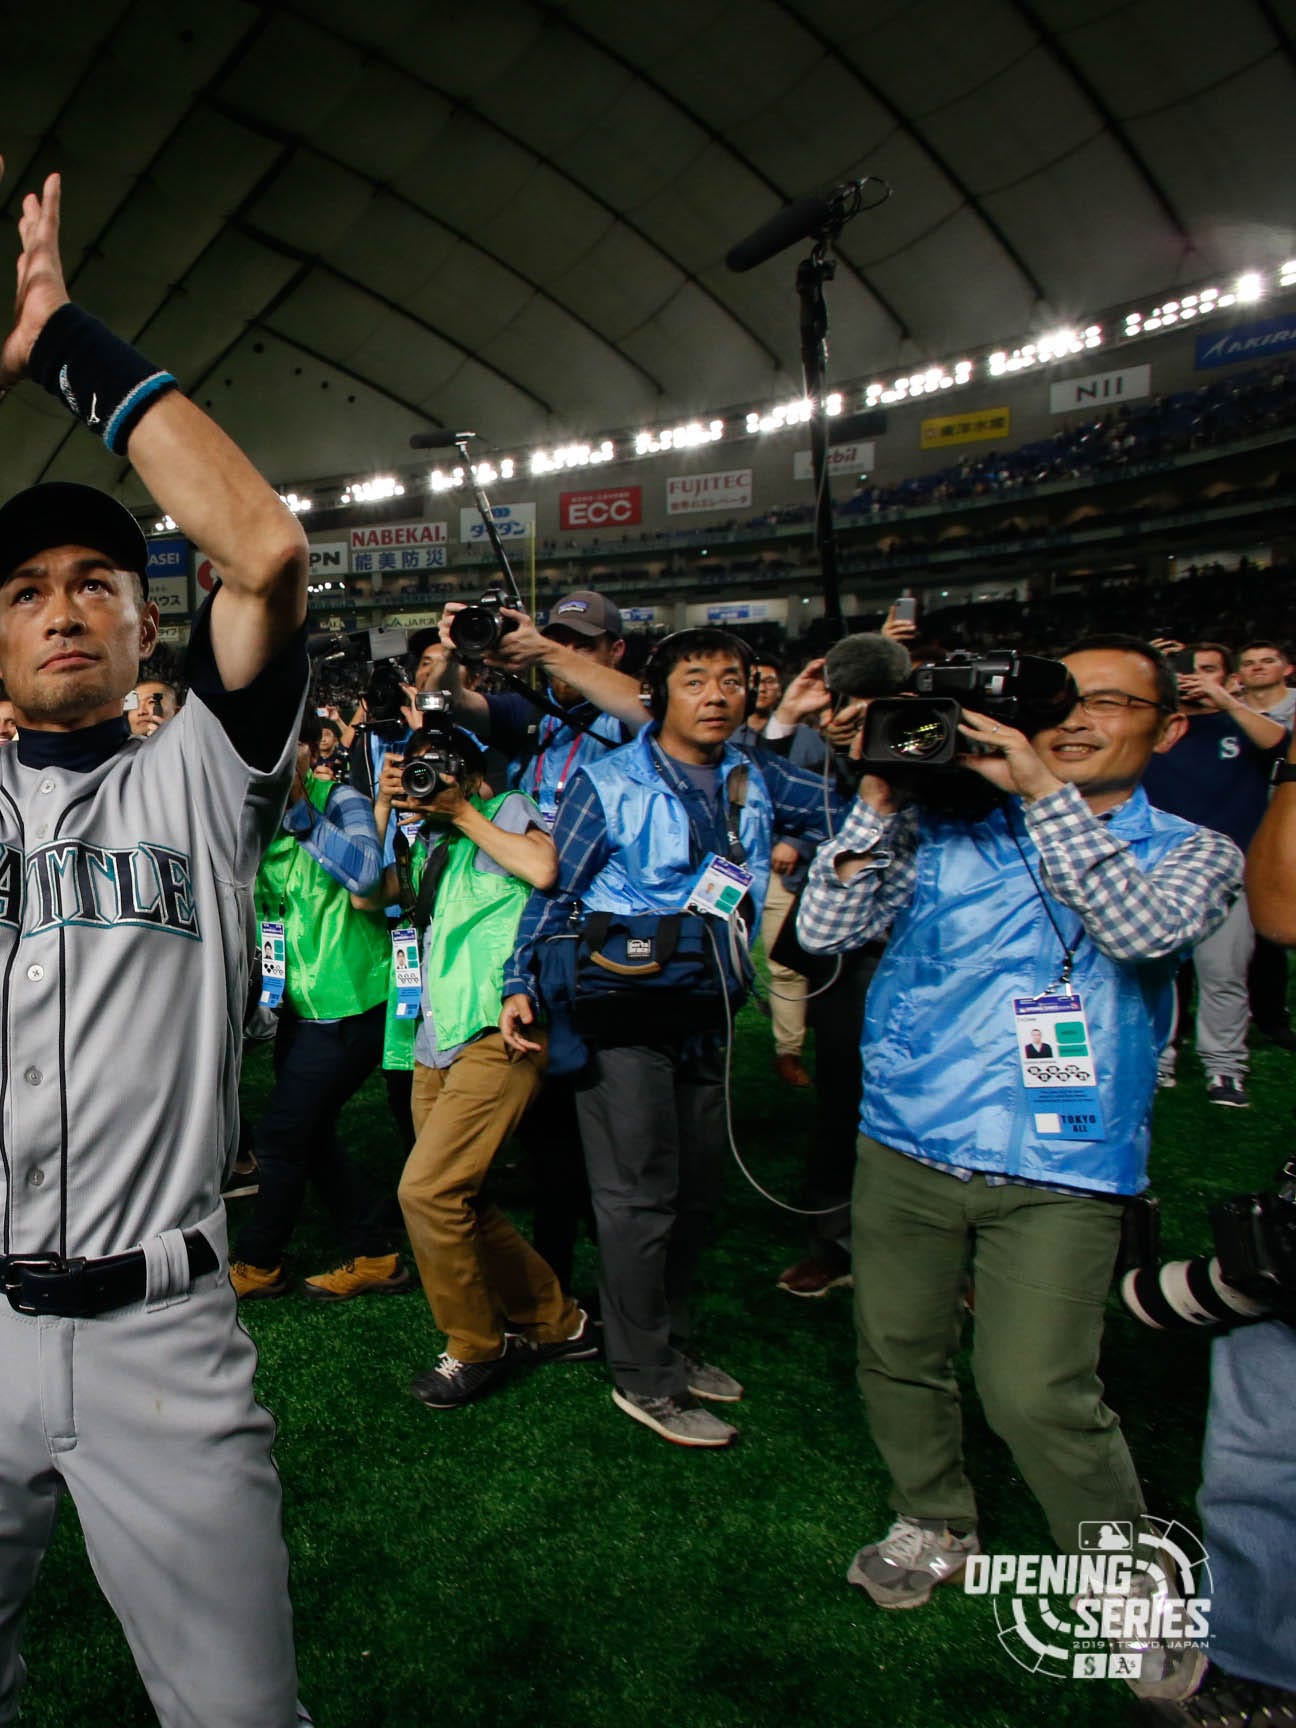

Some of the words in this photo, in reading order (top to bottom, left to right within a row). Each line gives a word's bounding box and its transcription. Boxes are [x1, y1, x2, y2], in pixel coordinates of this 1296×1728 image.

[669, 473, 751, 496] FUJITEC
[567, 500, 633, 526] ECC
[470, 522, 525, 539] ダダン
[355, 549, 444, 571] 能美防災
[1219, 736, 1241, 760] S
[1061, 1113, 1097, 1124] TOKYO
